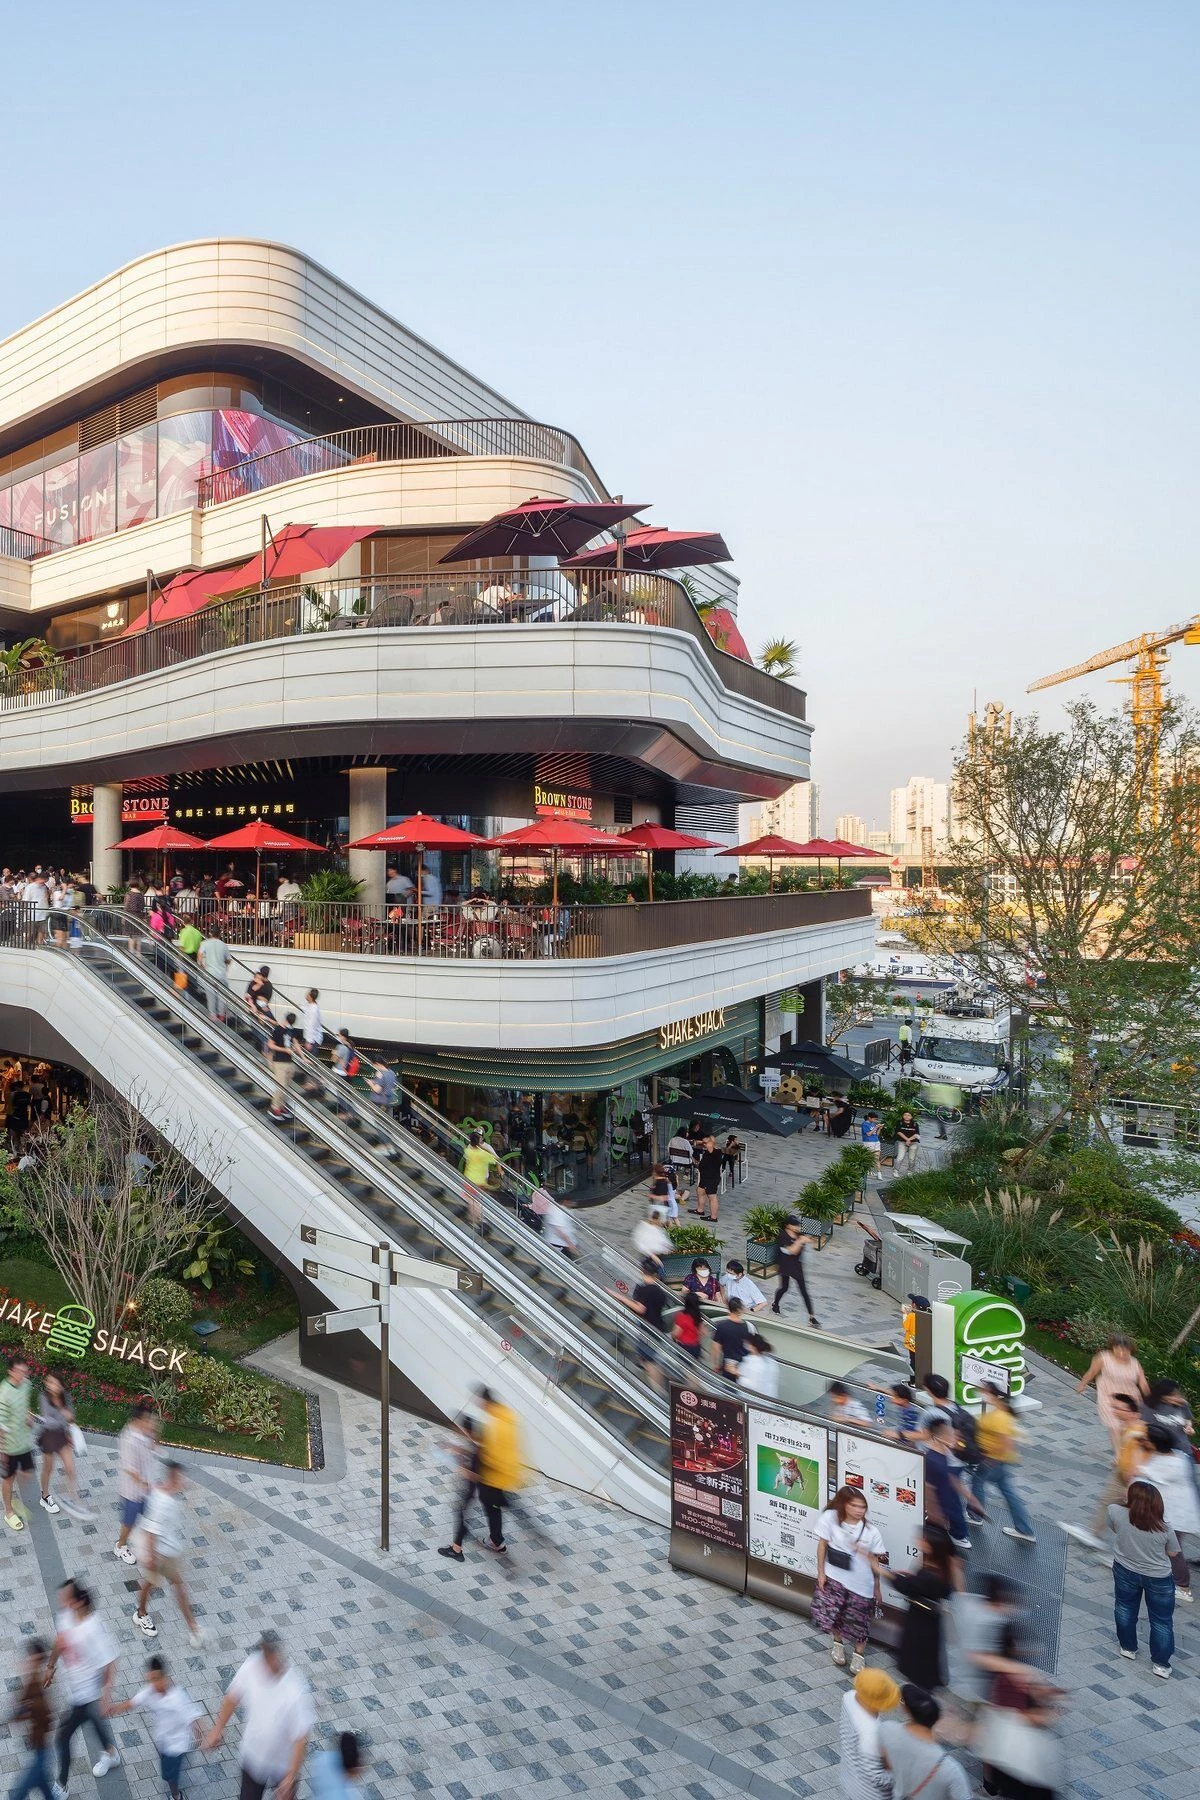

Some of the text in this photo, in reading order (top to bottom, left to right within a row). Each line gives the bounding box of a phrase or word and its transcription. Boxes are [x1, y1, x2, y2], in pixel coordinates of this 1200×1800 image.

[34, 488, 108, 531] FUSION
[123, 797, 170, 812] STONE
[660, 1007, 726, 1049] SHAKE SHACK
[93, 1329, 187, 1374] SHACK
[694, 1473, 743, 1497] 全新开业
[907, 1478, 916, 1489] L1
[906, 1545, 918, 1557] L2
